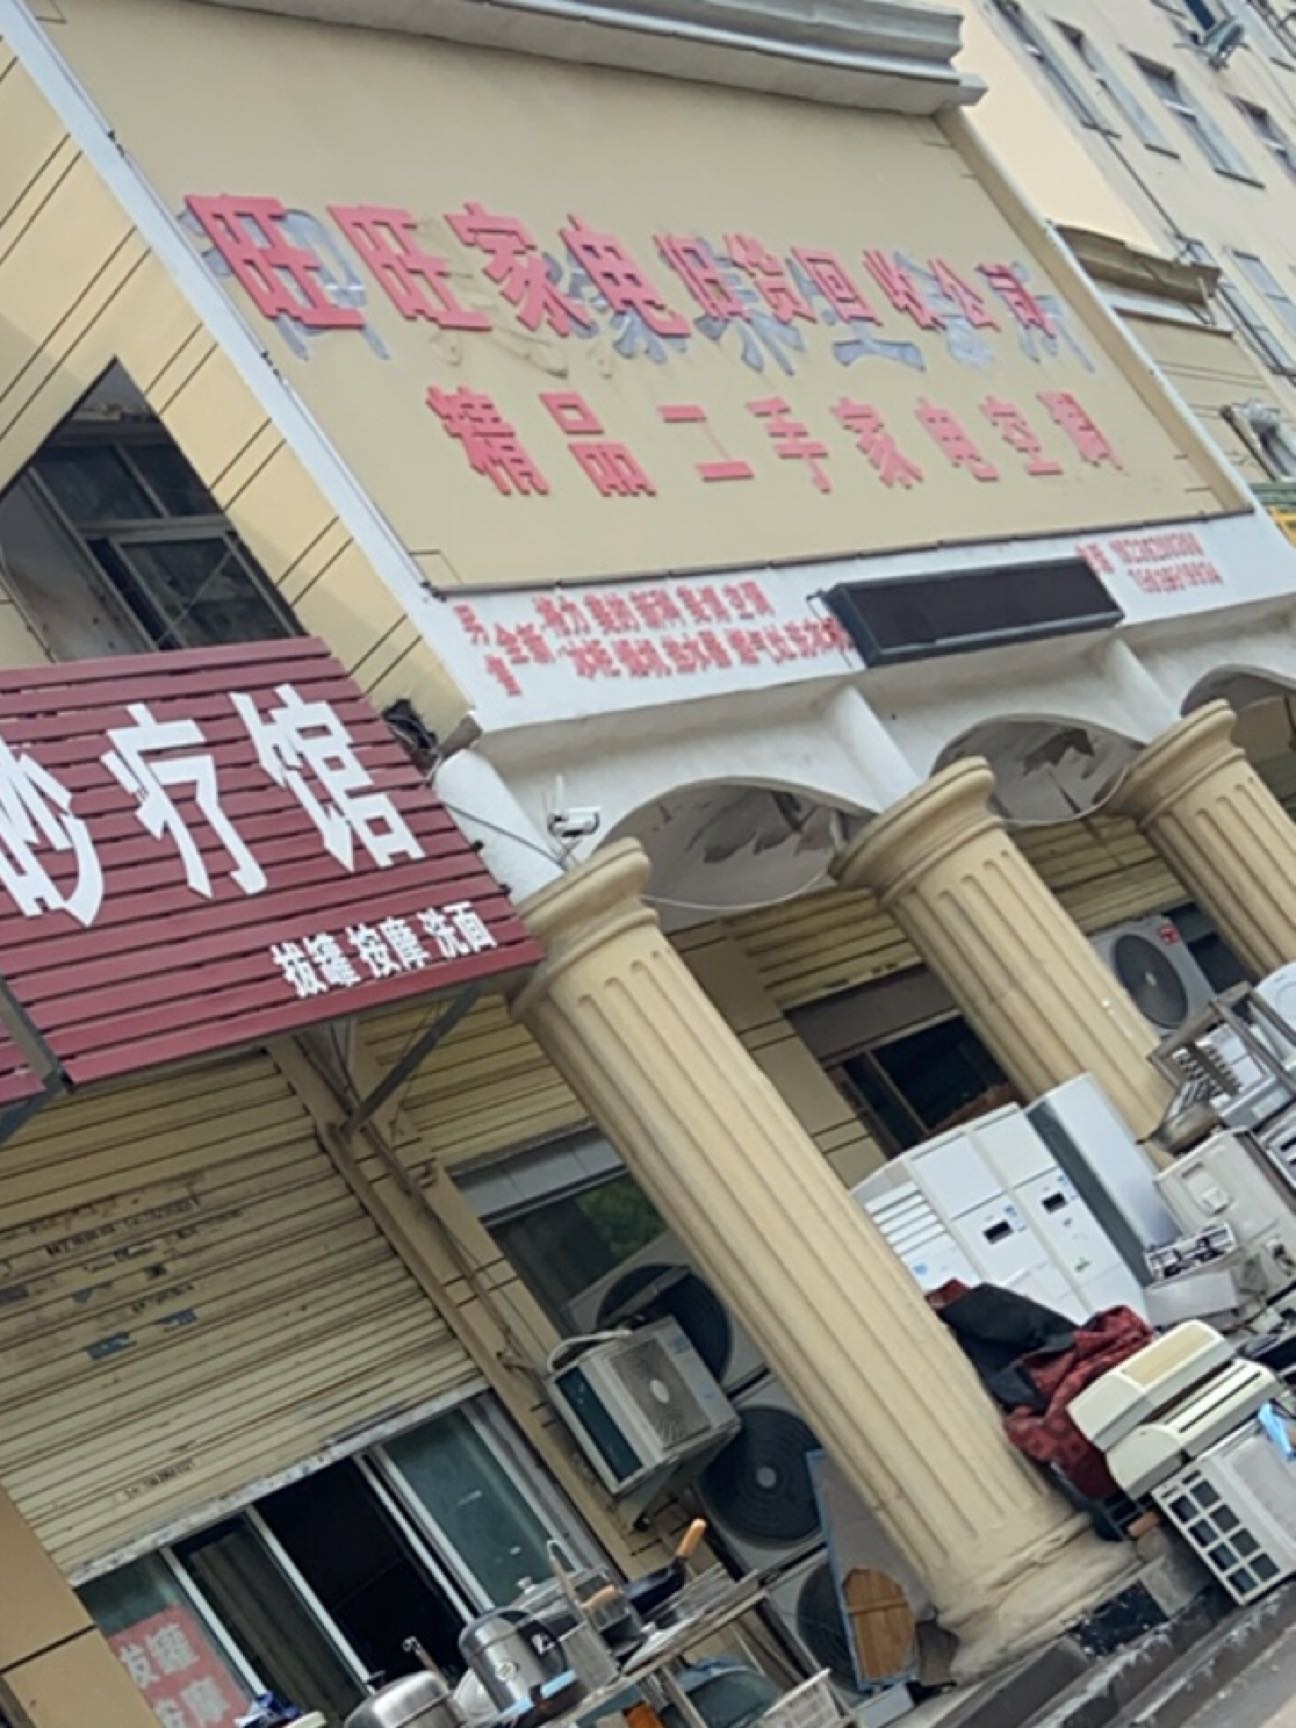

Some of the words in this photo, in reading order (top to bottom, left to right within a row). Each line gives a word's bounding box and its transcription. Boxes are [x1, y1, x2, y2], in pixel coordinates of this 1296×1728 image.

[186, 192, 1060, 339] 旺旺家电旧货回收公司
[425, 385, 1127, 499] 精品二手家电空调
